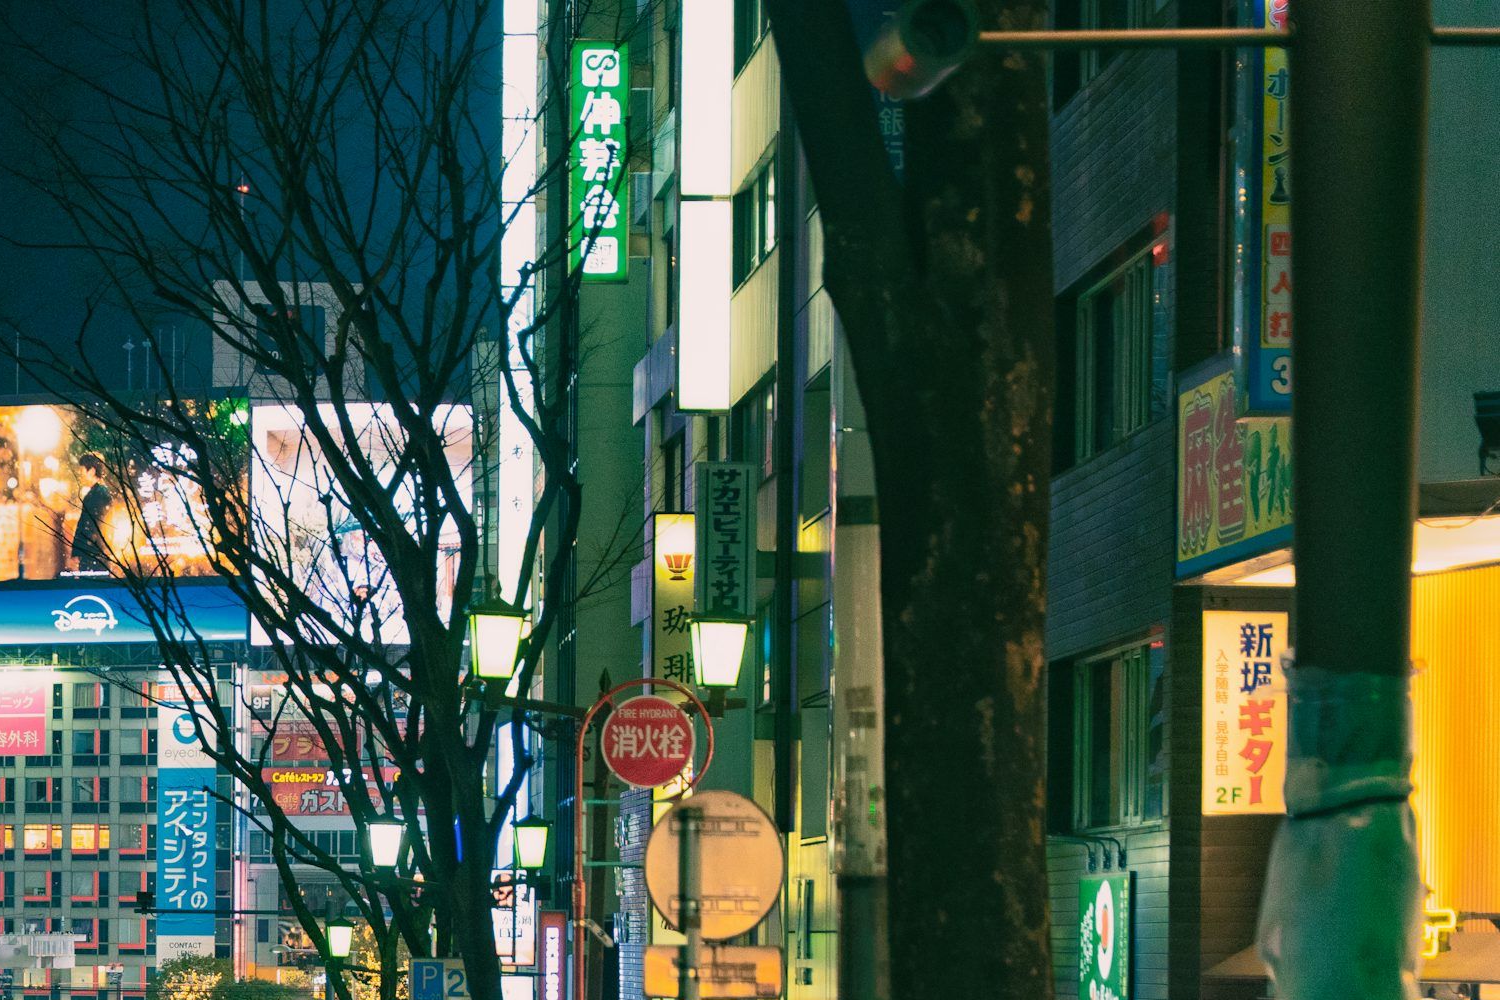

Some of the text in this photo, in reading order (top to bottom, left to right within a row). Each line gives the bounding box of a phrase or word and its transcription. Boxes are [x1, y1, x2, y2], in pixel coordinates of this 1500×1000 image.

[1182, 376, 1243, 552] 麻雀
[711, 469, 744, 608] サカエビューティサロ
[253, 697, 270, 709] 9F
[618, 709, 678, 718] FIRE HYDRANT
[1215, 649, 1229, 776] 入学随時・見学自由
[1238, 623, 1275, 806] 新堀ギター
[611, 724, 687, 758] 消火栓
[301, 789, 347, 813] ガスト
[1216, 787, 1243, 804] 2F
[163, 790, 187, 909] アイシティ
[191, 790, 208, 909] コンタクトの
[168, 941, 202, 949] CONTACT
[422, 965, 438, 989] P
[447, 970, 472, 996] 2
